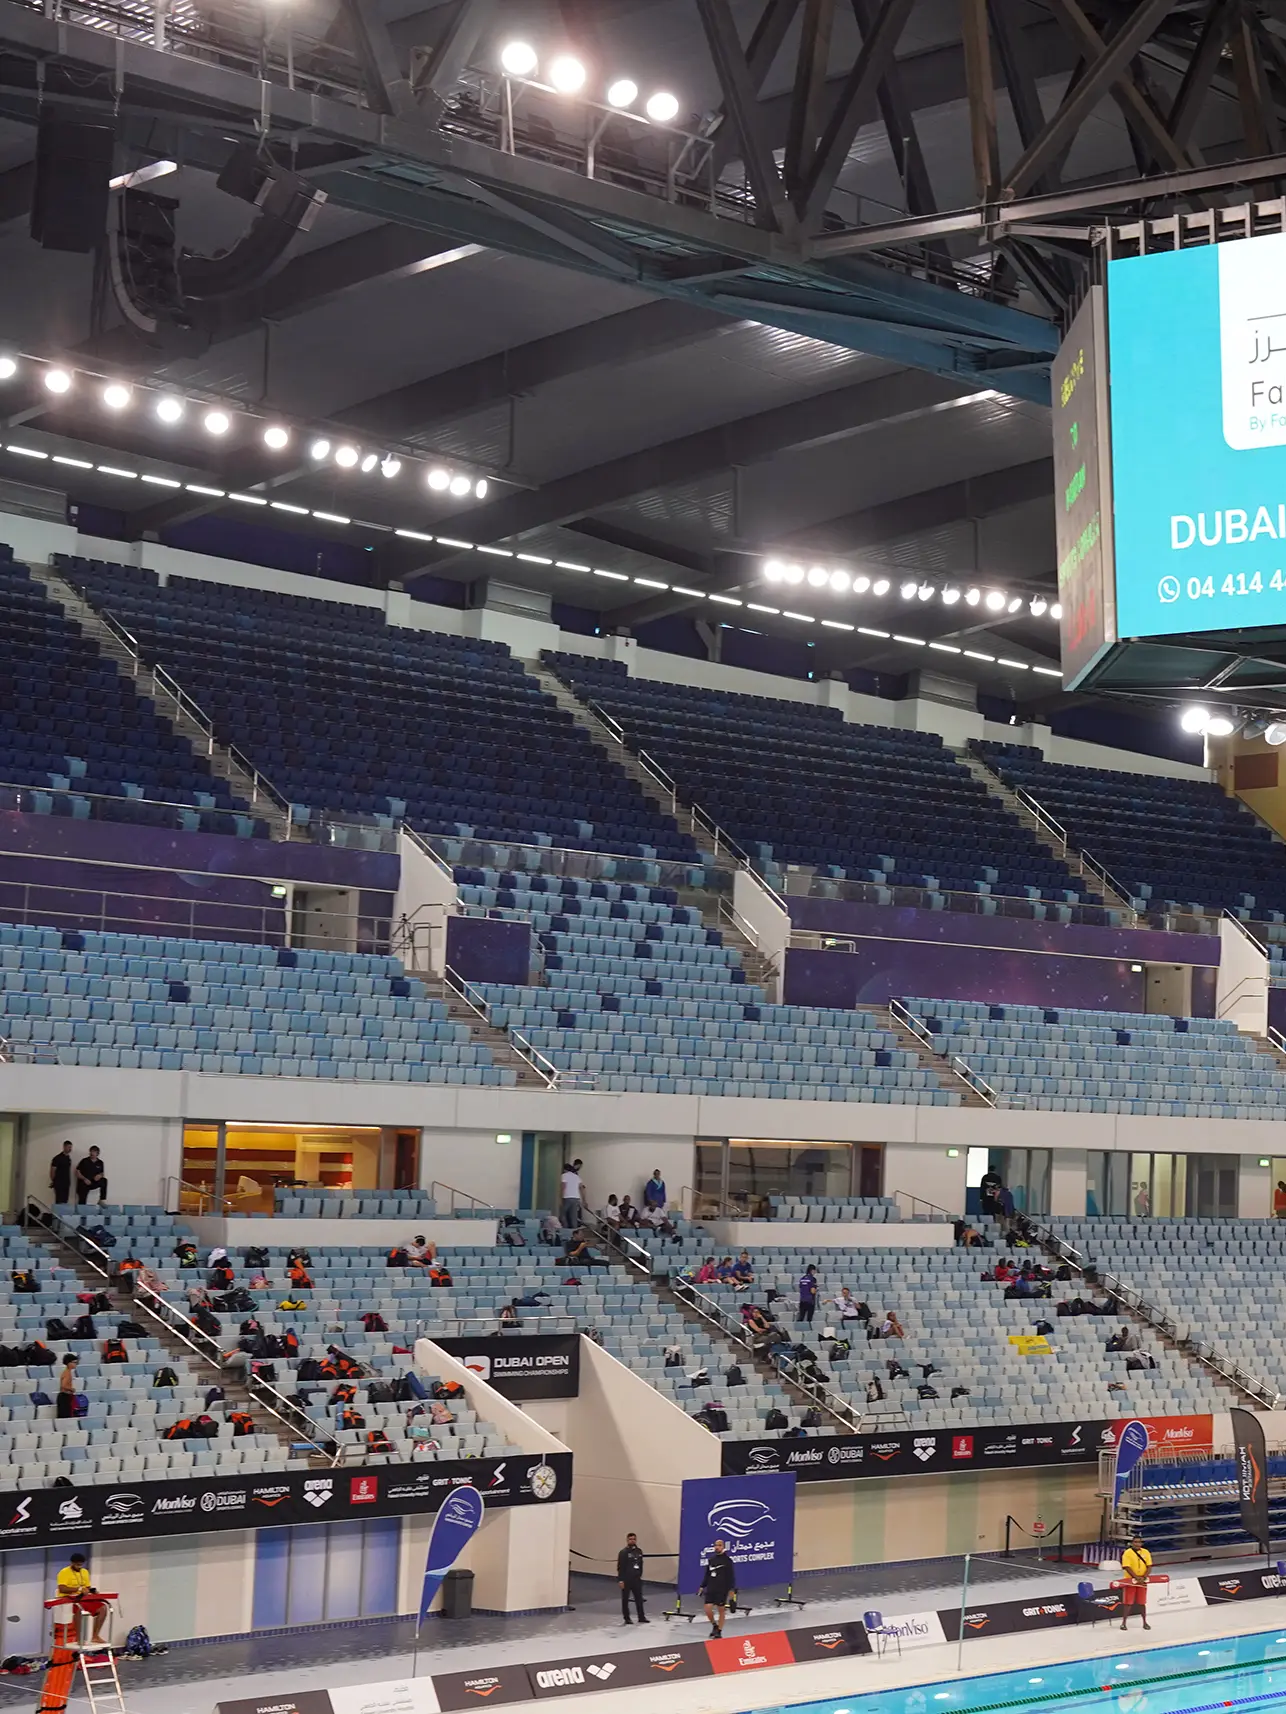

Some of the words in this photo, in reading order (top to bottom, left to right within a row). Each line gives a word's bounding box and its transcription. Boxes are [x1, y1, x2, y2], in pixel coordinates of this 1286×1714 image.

[1249, 417, 1267, 431] By
[1170, 504, 1286, 549] DUBAI
[1187, 576, 1215, 600] 04
[1221, 571, 1264, 596] 414
[494, 1357, 533, 1368] DUBAI
[535, 1355, 569, 1366] OPEN
[914, 1437, 936, 1447] arena
[840, 1449, 864, 1459] DUBAI
[253, 1486, 290, 1495] HAMILTON
[304, 1479, 333, 1491] arena
[216, 1494, 247, 1506] DUBAI
[749, 1552, 775, 1561] COMPLEX
[813, 1631, 842, 1641] HAMILTON
[650, 1652, 682, 1664] HAMILTON
[738, 1656, 768, 1667] Emirates
[464, 1676, 499, 1688] HAMILTON
[536, 1665, 585, 1689] arena
[256, 1702, 297, 1714] HAMILTON
